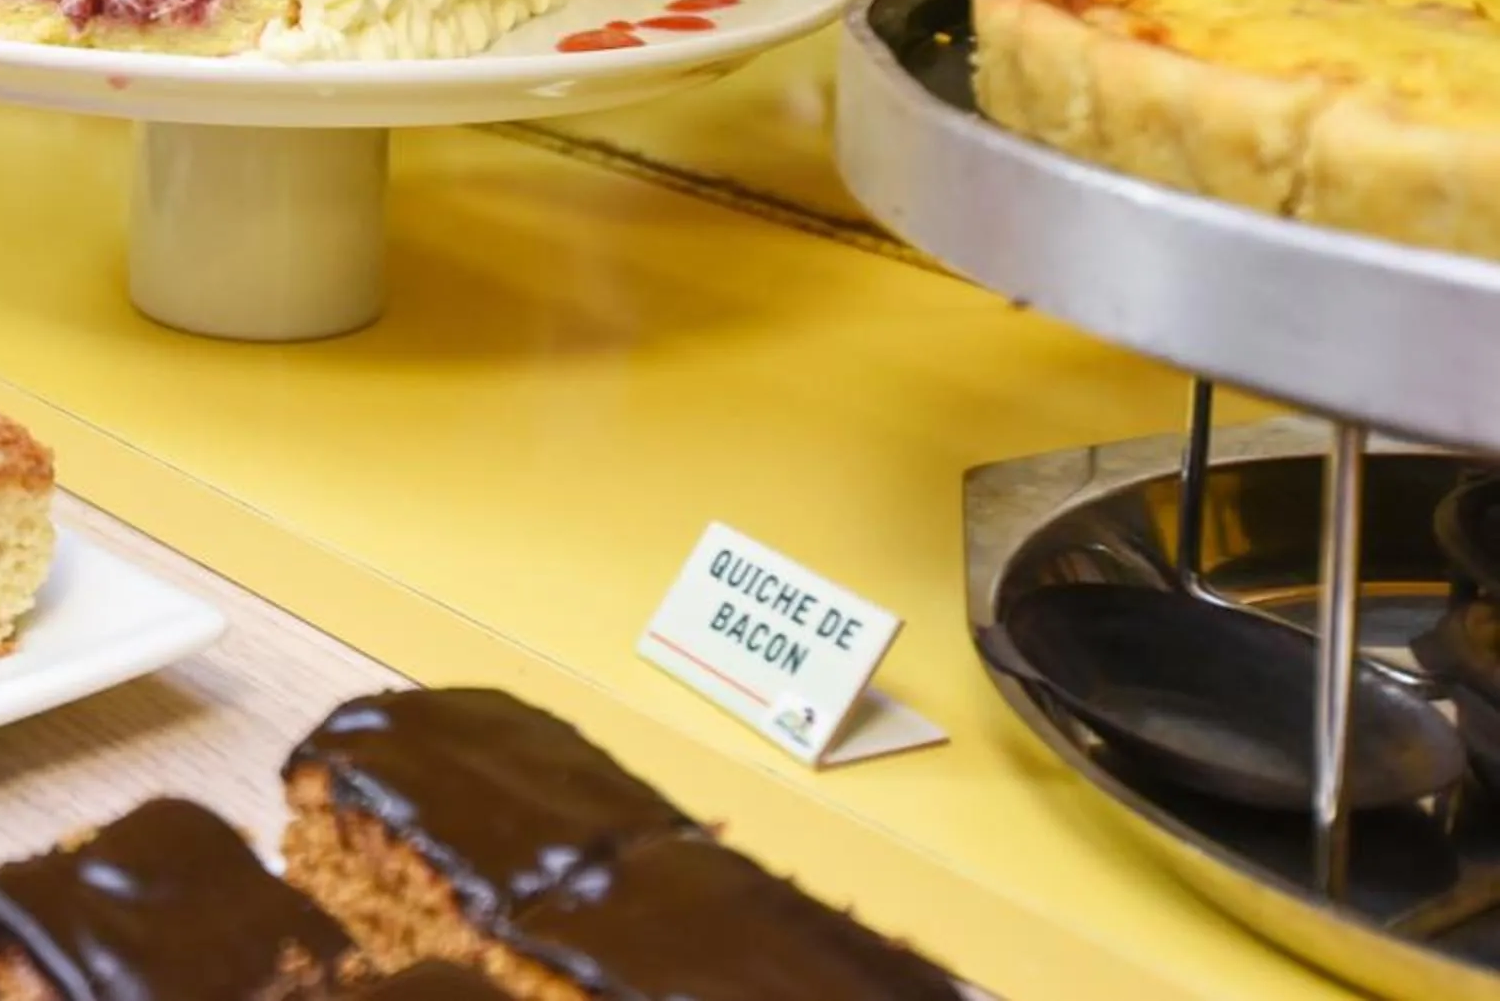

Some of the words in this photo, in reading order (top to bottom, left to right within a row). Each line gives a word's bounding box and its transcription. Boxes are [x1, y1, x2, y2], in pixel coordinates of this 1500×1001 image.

[709, 550, 818, 626] QUICHE
[816, 607, 864, 651] DE
[710, 602, 810, 676] BACON
